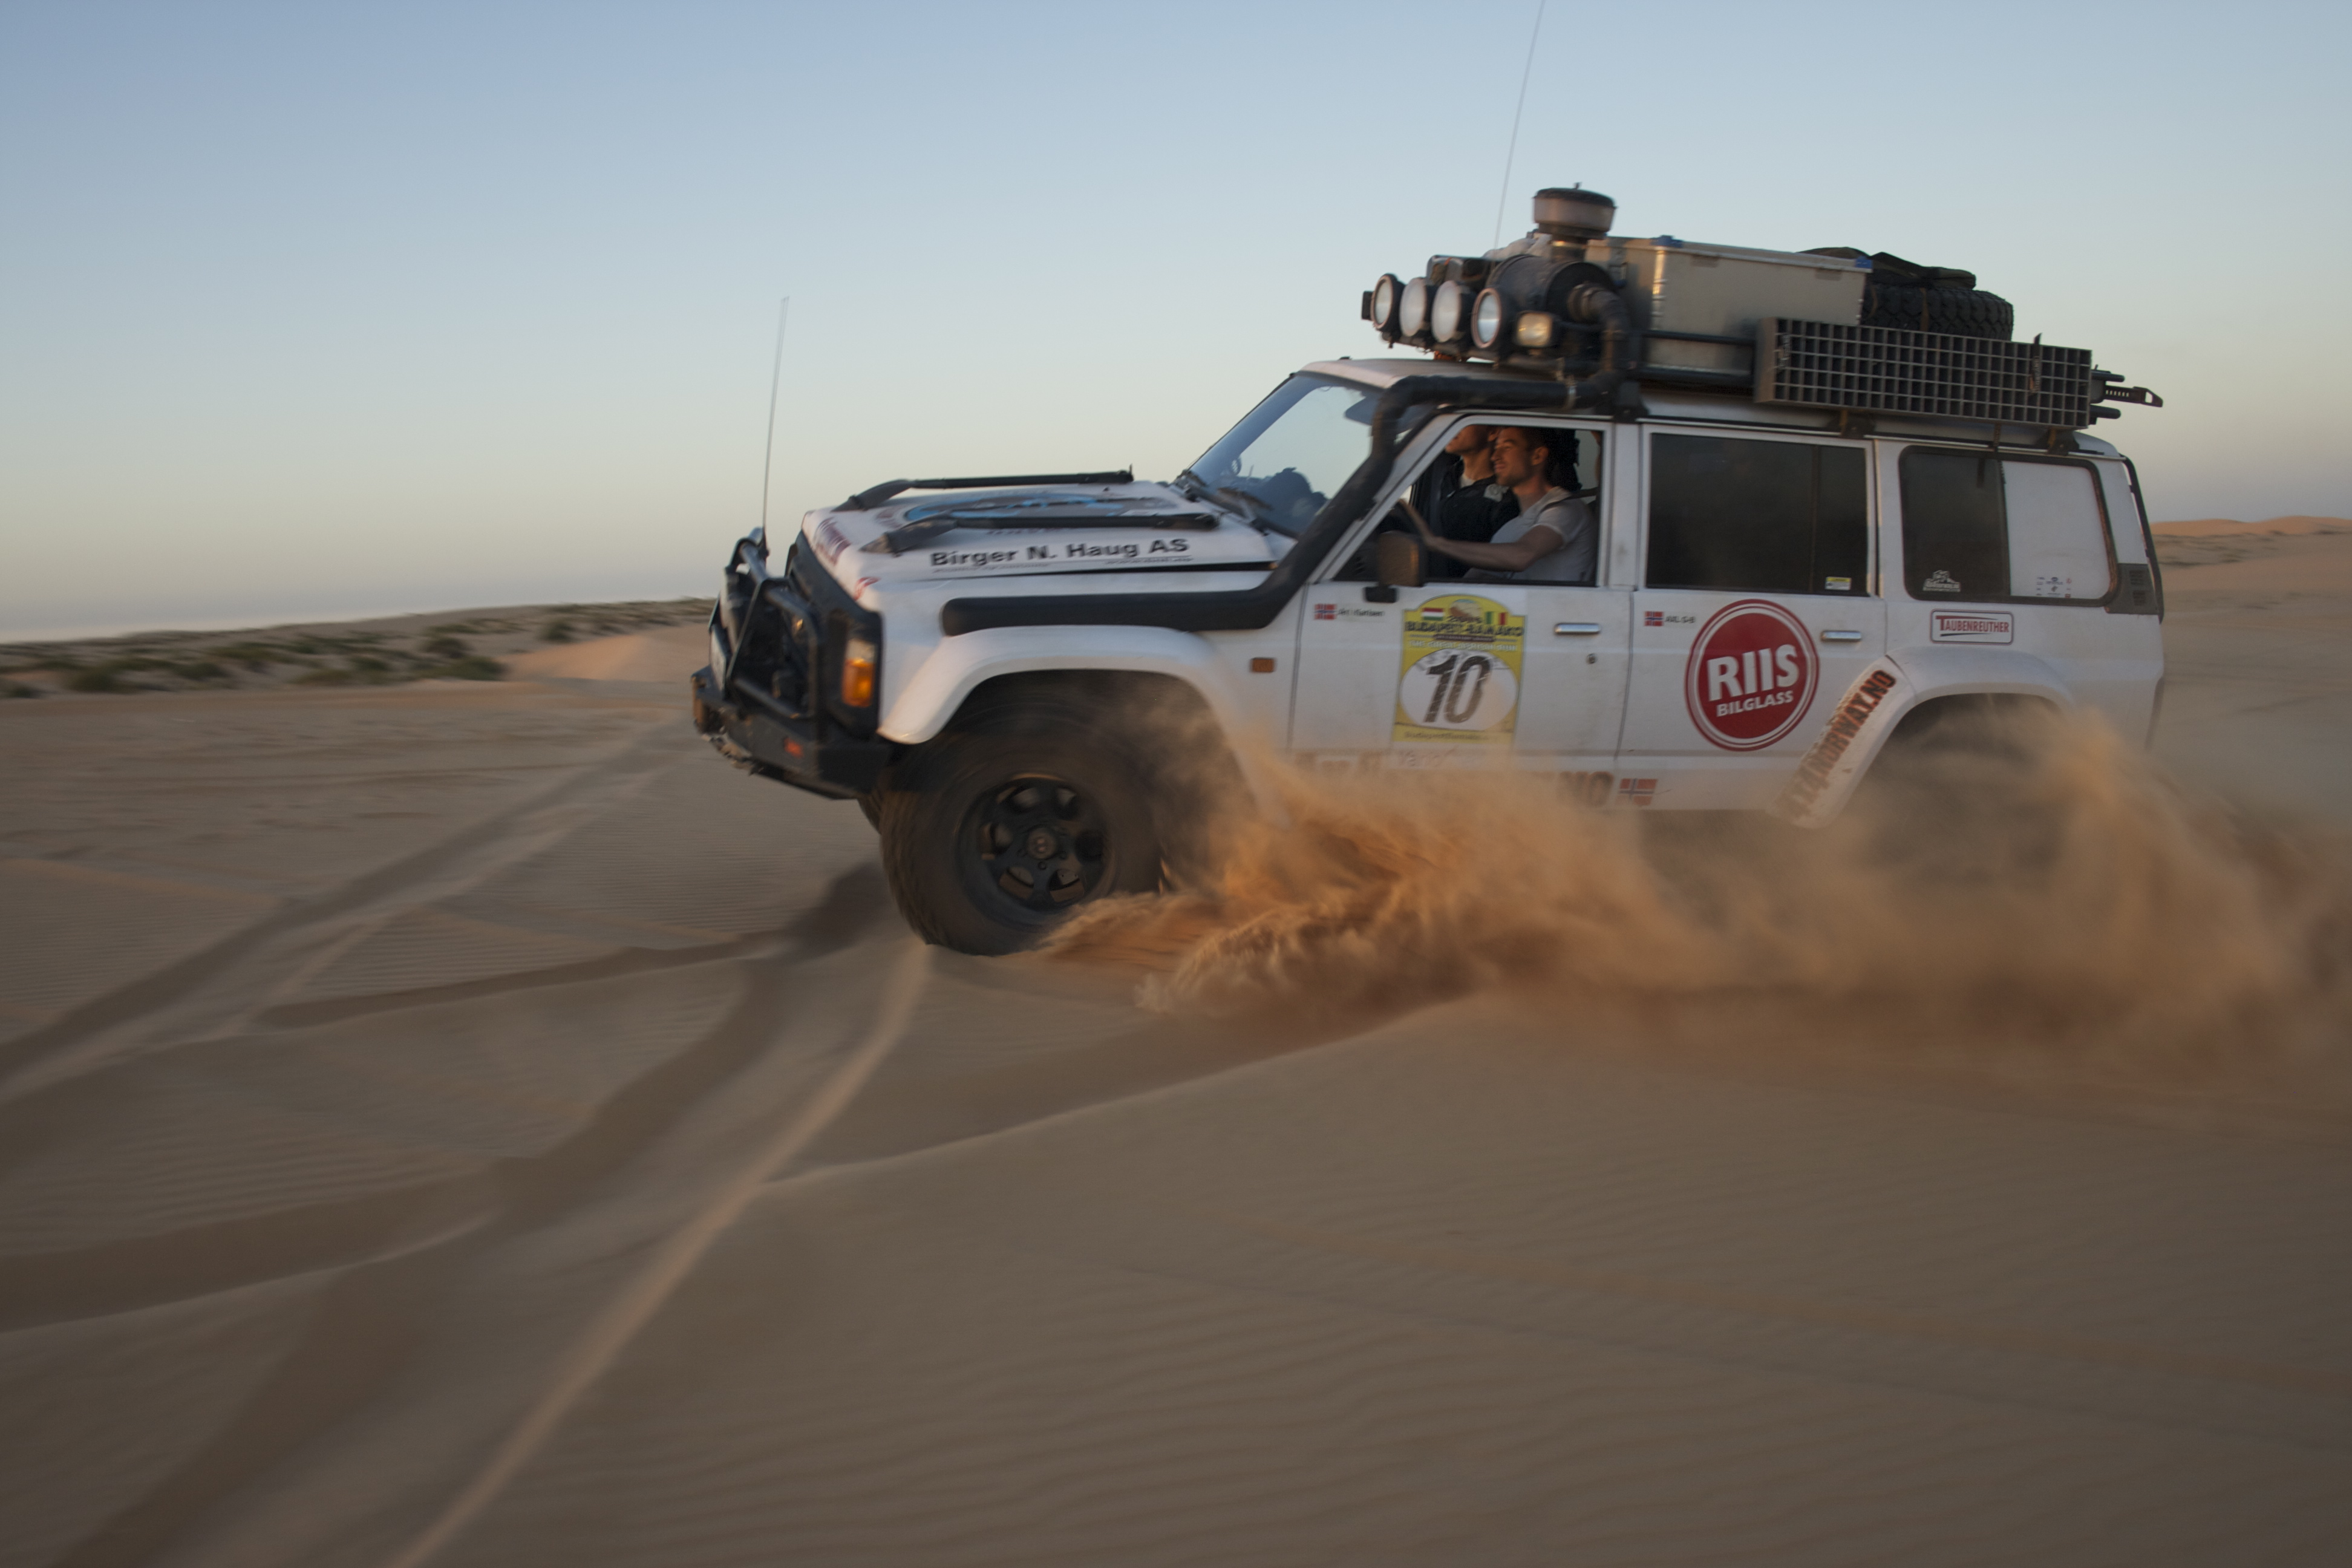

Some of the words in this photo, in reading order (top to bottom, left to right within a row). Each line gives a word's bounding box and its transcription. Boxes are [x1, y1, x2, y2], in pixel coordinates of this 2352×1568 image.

[930, 549, 1019, 567] Birger
[1026, 545, 1057, 560] N.
[1066, 543, 1140, 559] Haug
[1148, 538, 1191, 554] AS
[1935, 615, 2010, 633] TAUBENREUTHER
[1707, 644, 1800, 702] RIIS
[1422, 654, 1491, 724] 10
[1716, 690, 1794, 717] BILGLASS
